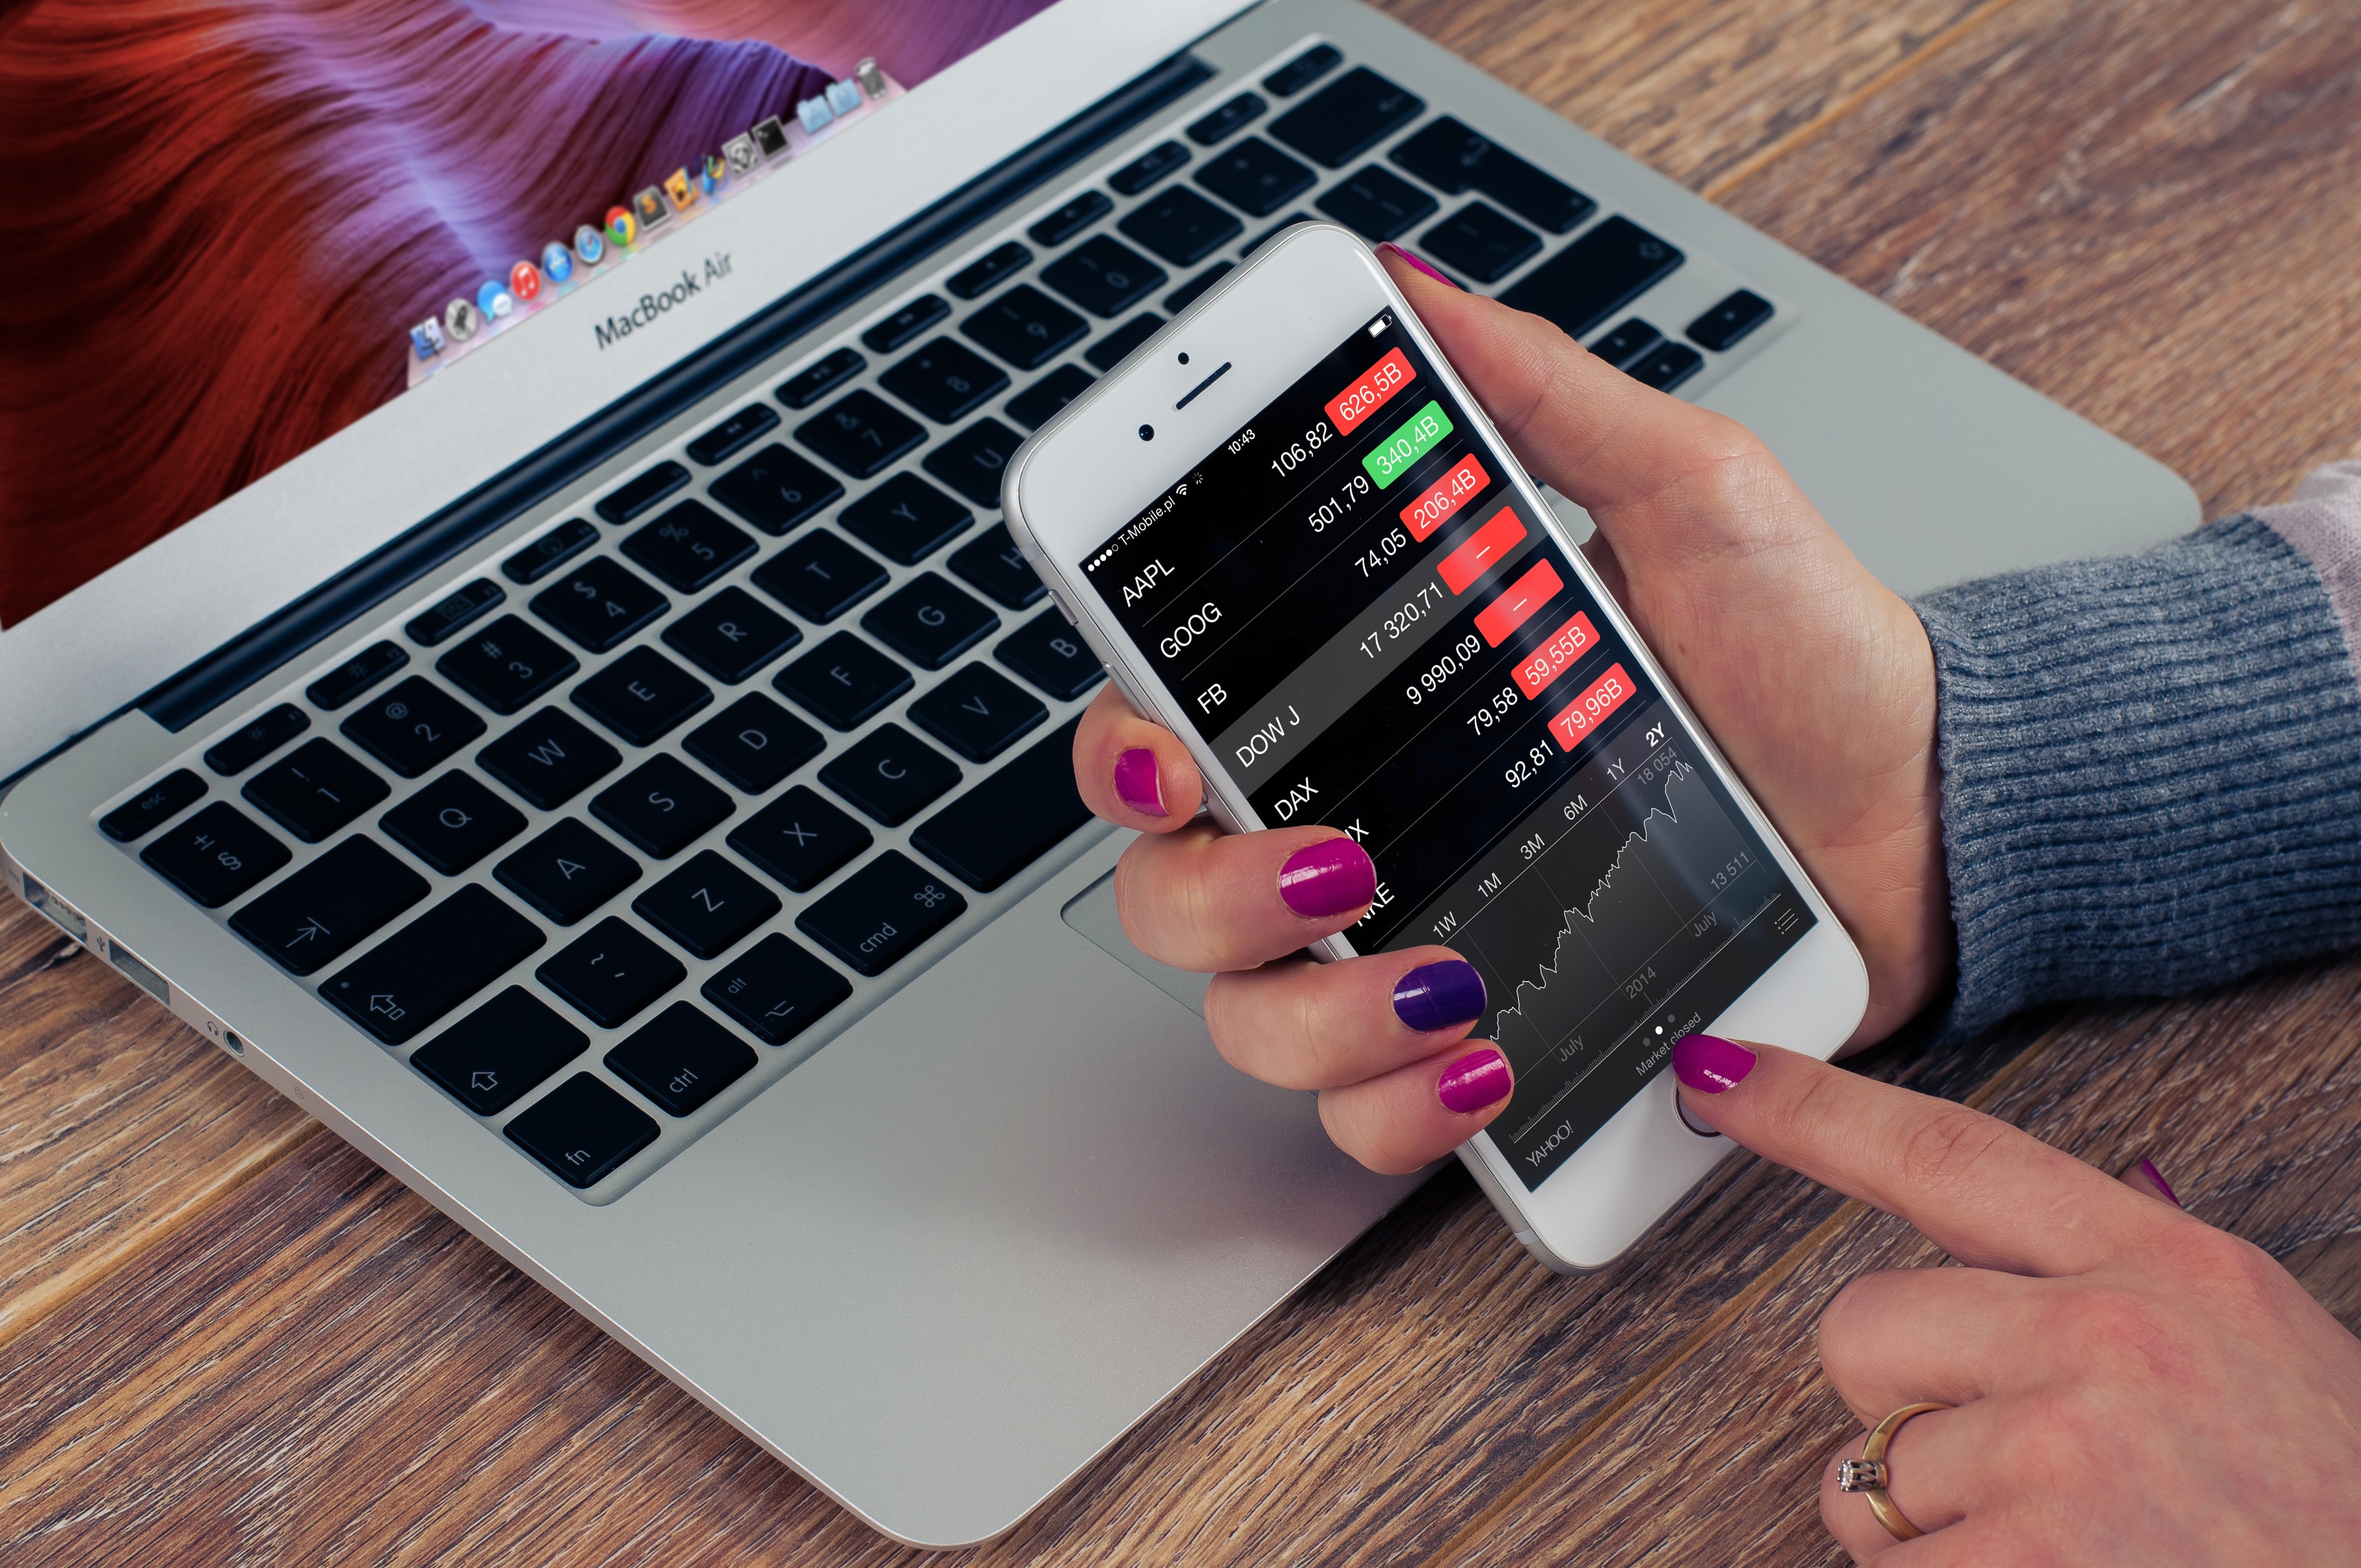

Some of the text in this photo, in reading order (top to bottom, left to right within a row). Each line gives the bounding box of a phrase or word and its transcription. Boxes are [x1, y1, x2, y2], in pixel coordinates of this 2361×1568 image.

[594, 252, 733, 351] MacBook Air
[1026, 323, 1048, 337] 9
[946, 376, 971, 393] 8
[835, 412, 859, 429] &
[862, 428, 883, 447] 7
[1227, 429, 1255, 455] 10:43
[973, 447, 1004, 470] U
[780, 487, 802, 503] 6
[1123, 363, 1401, 607] AAPL 106,82 626,5B
[891, 503, 917, 521] Y
[1118, 496, 1175, 545] T-Mobile.pl
[659, 525, 690, 542] %
[1161, 416, 1438, 657] GOOG 501,79 340,4B
[691, 542, 715, 560] 5
[805, 561, 831, 580] T
[1198, 469, 1475, 714] FB 74,05 206,4B
[605, 600, 627, 617] 4
[917, 606, 946, 627] G
[717, 622, 747, 642] R
[481, 640, 502, 659] #
[1049, 638, 1078, 658] B
[508, 661, 534, 679] 3
[829, 666, 851, 687] F
[1236, 717, 1285, 767] DOW
[1289, 705, 1299, 725] J
[1361, 631, 1381, 658] 17
[1384, 582, 1443, 638] 320,71
[627, 680, 656, 701] E
[1467, 688, 1517, 735] 79,58
[1525, 627, 1585, 685] 59,55B
[385, 702, 409, 720] @
[961, 695, 990, 716] V
[414, 723, 441, 742] 2
[1275, 777, 1319, 821] DAX
[1407, 687, 1421, 704] 9
[1421, 635, 1480, 692] 990,09
[1506, 740, 1553, 787] 92,81
[1560, 679, 1622, 737] 79,96B
[738, 729, 768, 750] D
[528, 738, 566, 766] W
[877, 759, 907, 780] C
[1637, 747, 1677, 786] 18 054
[140, 790, 167, 811] esc
[317, 787, 340, 803] 1
[648, 791, 675, 812] S
[439, 808, 473, 829] Q
[782, 821, 818, 847] X
[1433, 722, 1666, 938] 1W 1M 3M 6M 1Y 2Y
[556, 858, 586, 880] A
[1710, 873, 1727, 890] 13
[690, 888, 725, 913] Z
[861, 923, 897, 952] cmd
[728, 978, 747, 993] alt
[1560, 911, 1717, 1062] July 2014 July
[1636, 1012, 1701, 1075] Market closed
[670, 1069, 698, 1092] ctrl
[1526, 1120, 1573, 1166] YAHOO!
[566, 1151, 590, 1165] fn
